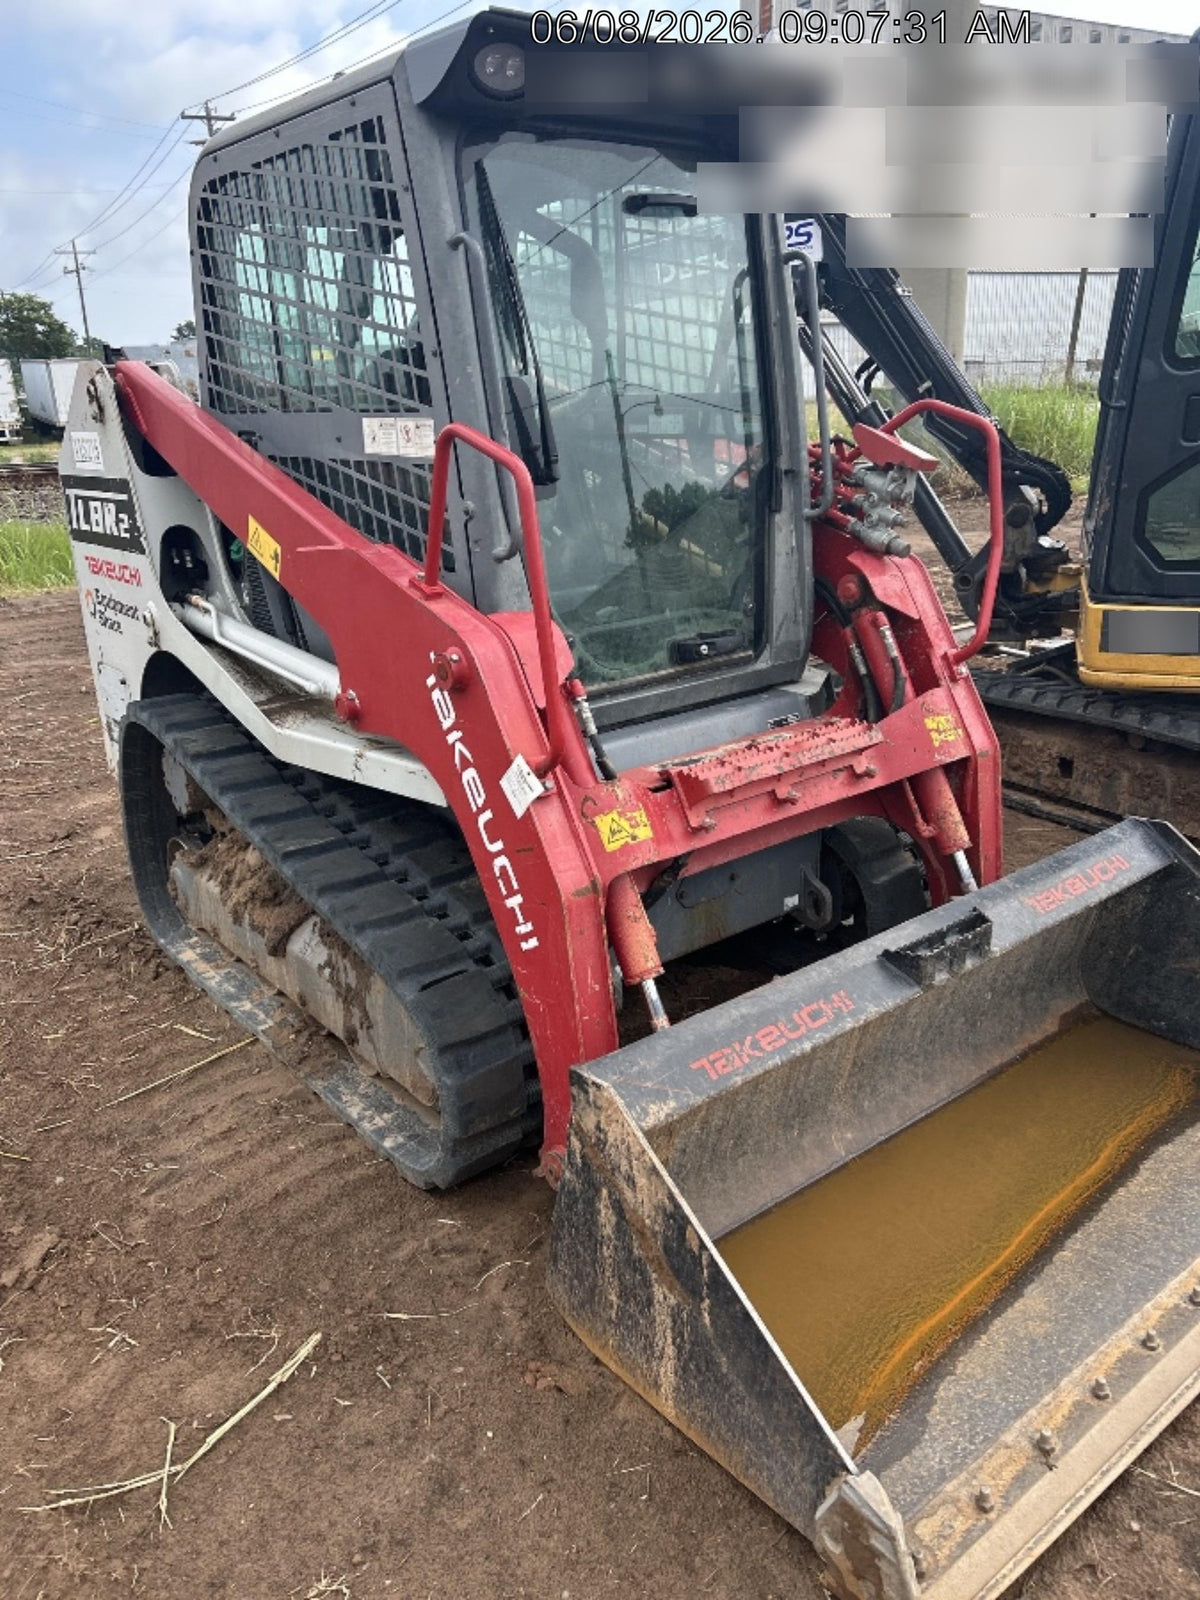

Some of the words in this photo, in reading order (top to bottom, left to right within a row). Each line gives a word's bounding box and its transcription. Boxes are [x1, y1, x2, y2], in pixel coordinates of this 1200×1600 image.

[85, 555, 142, 588] TAKEUCHI
[1026, 854, 1130, 914] TAKEUCHI
[689, 990, 856, 1081] TAKEUCHI
